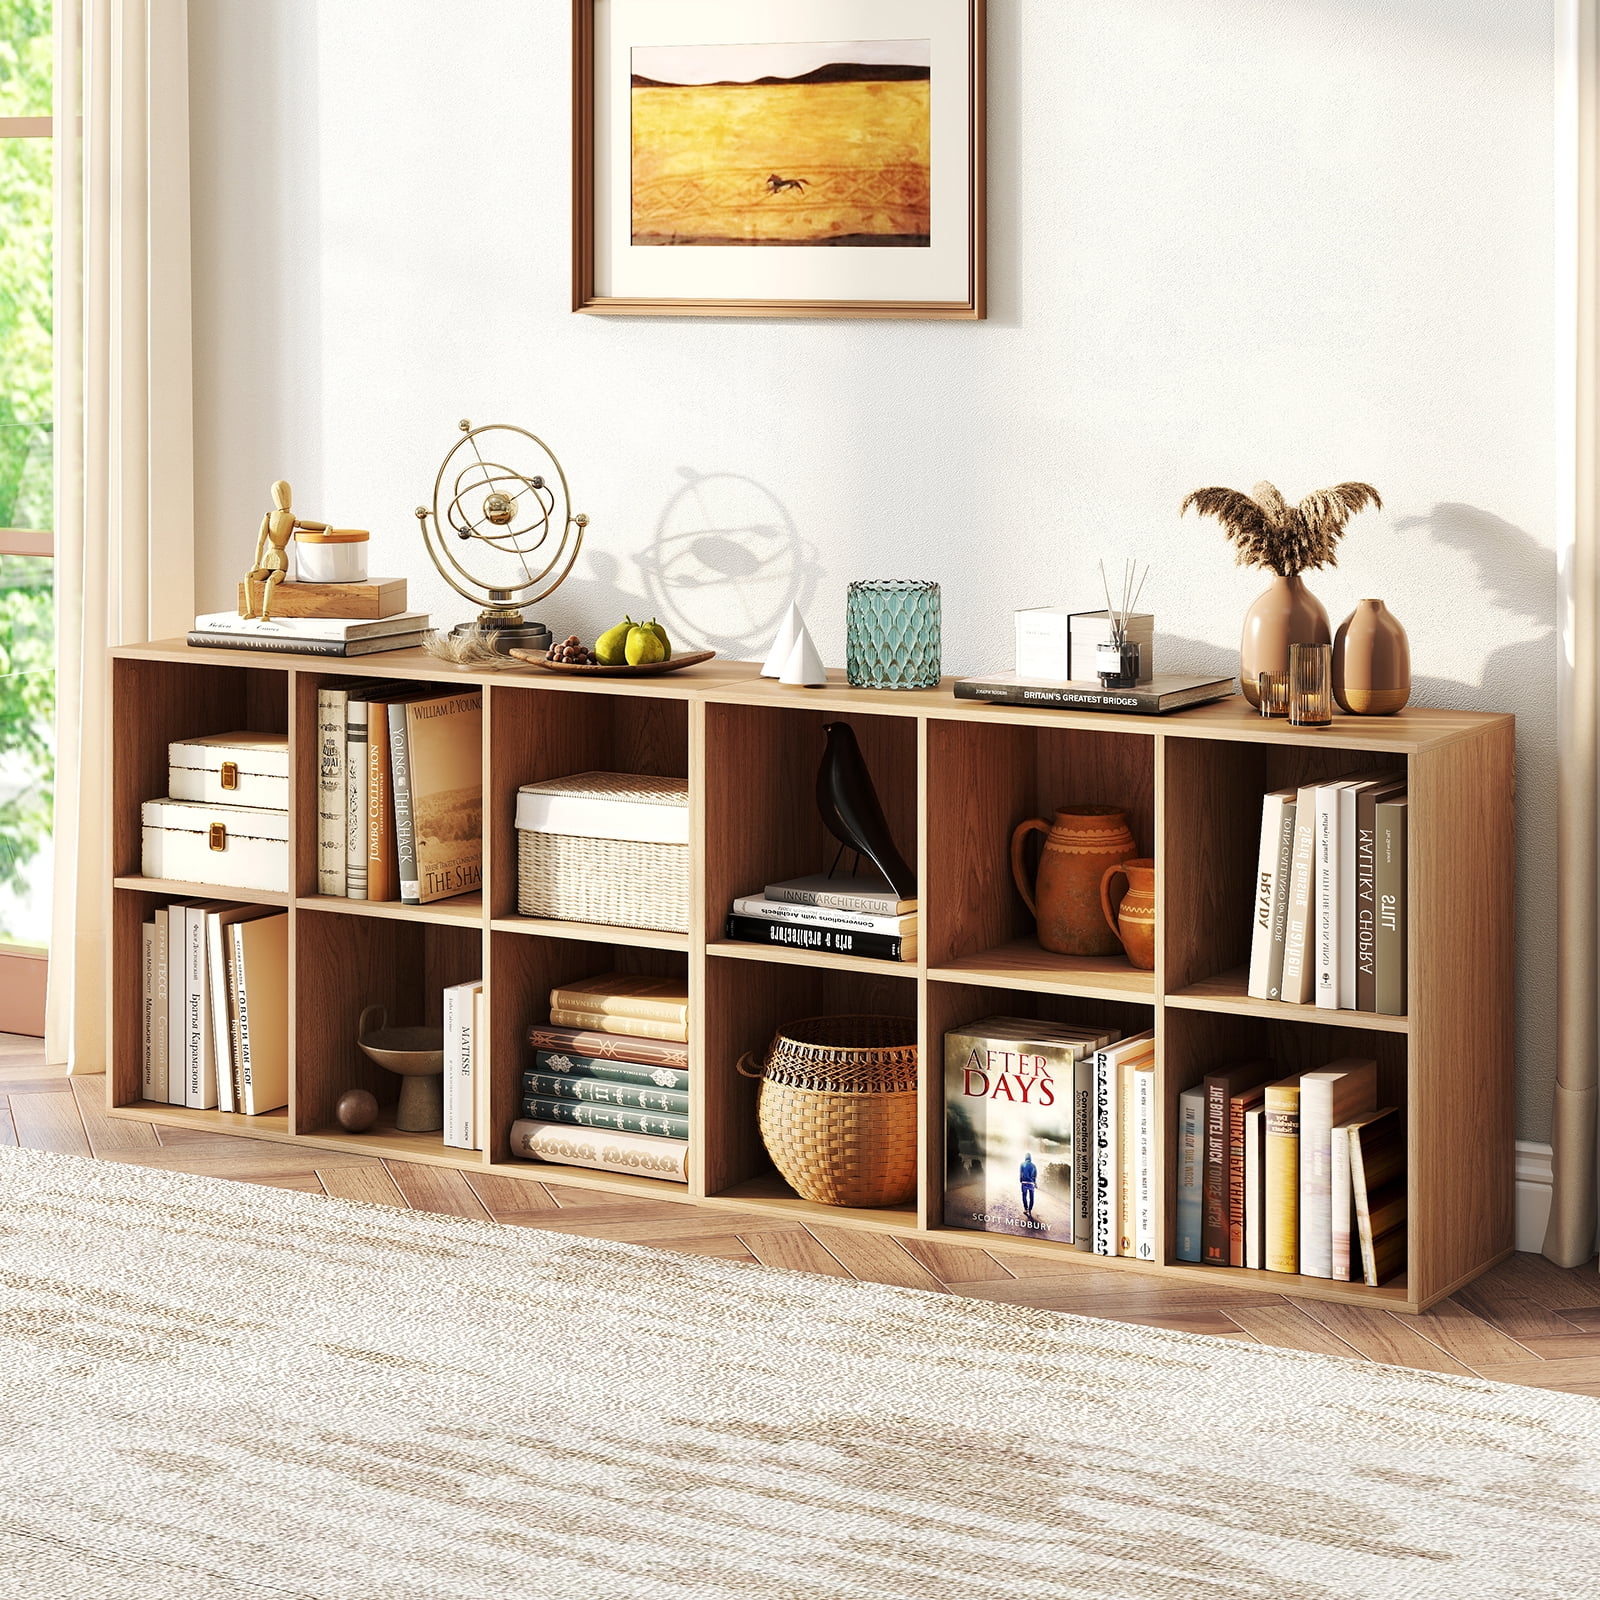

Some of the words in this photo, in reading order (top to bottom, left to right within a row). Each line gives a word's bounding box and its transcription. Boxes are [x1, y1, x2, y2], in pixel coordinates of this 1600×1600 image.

[1024, 690, 1061, 701] BRITAIN'S
[1062, 693, 1101, 704] GREATEST
[1103, 696, 1138, 706] BRIDGES
[414, 705, 448, 720] WILLIAM
[393, 728, 405, 775] YOUNG
[369, 744, 378, 818] COLLECTION
[395, 790, 409, 815] THE
[369, 822, 382, 861] JUMBO
[399, 820, 412, 864] SHACK
[426, 872, 452, 894] THE
[453, 866, 482, 889] SHA
[761, 908, 799, 918] Architects
[783, 890, 888, 911] INNENARCHITEKTUR
[770, 925, 821, 946] architecture
[818, 916, 874, 928] Conversations
[825, 933, 831, 945] &
[835, 934, 852, 950] arts
[158, 962, 166, 1000] ГЕССЕ
[189, 994, 200, 1029] Братья
[239, 990, 248, 1040] ГОВОРИ
[190, 1032, 200, 1094] Карамазовы
[242, 1044, 250, 1064] КАК
[461, 1026, 470, 1076] MATISSE
[965, 1048, 1052, 1079] AFTER
[243, 1068, 252, 1086] БОГ
[963, 1066, 1055, 1106] DAYS
[1081, 1090, 1089, 1153] Conversations
[1081, 1155, 1089, 1173] with
[1081, 1175, 1089, 1219] Architects
[972, 1212, 1001, 1224] SCOTT
[1005, 1216, 1052, 1231] MEDBURY
